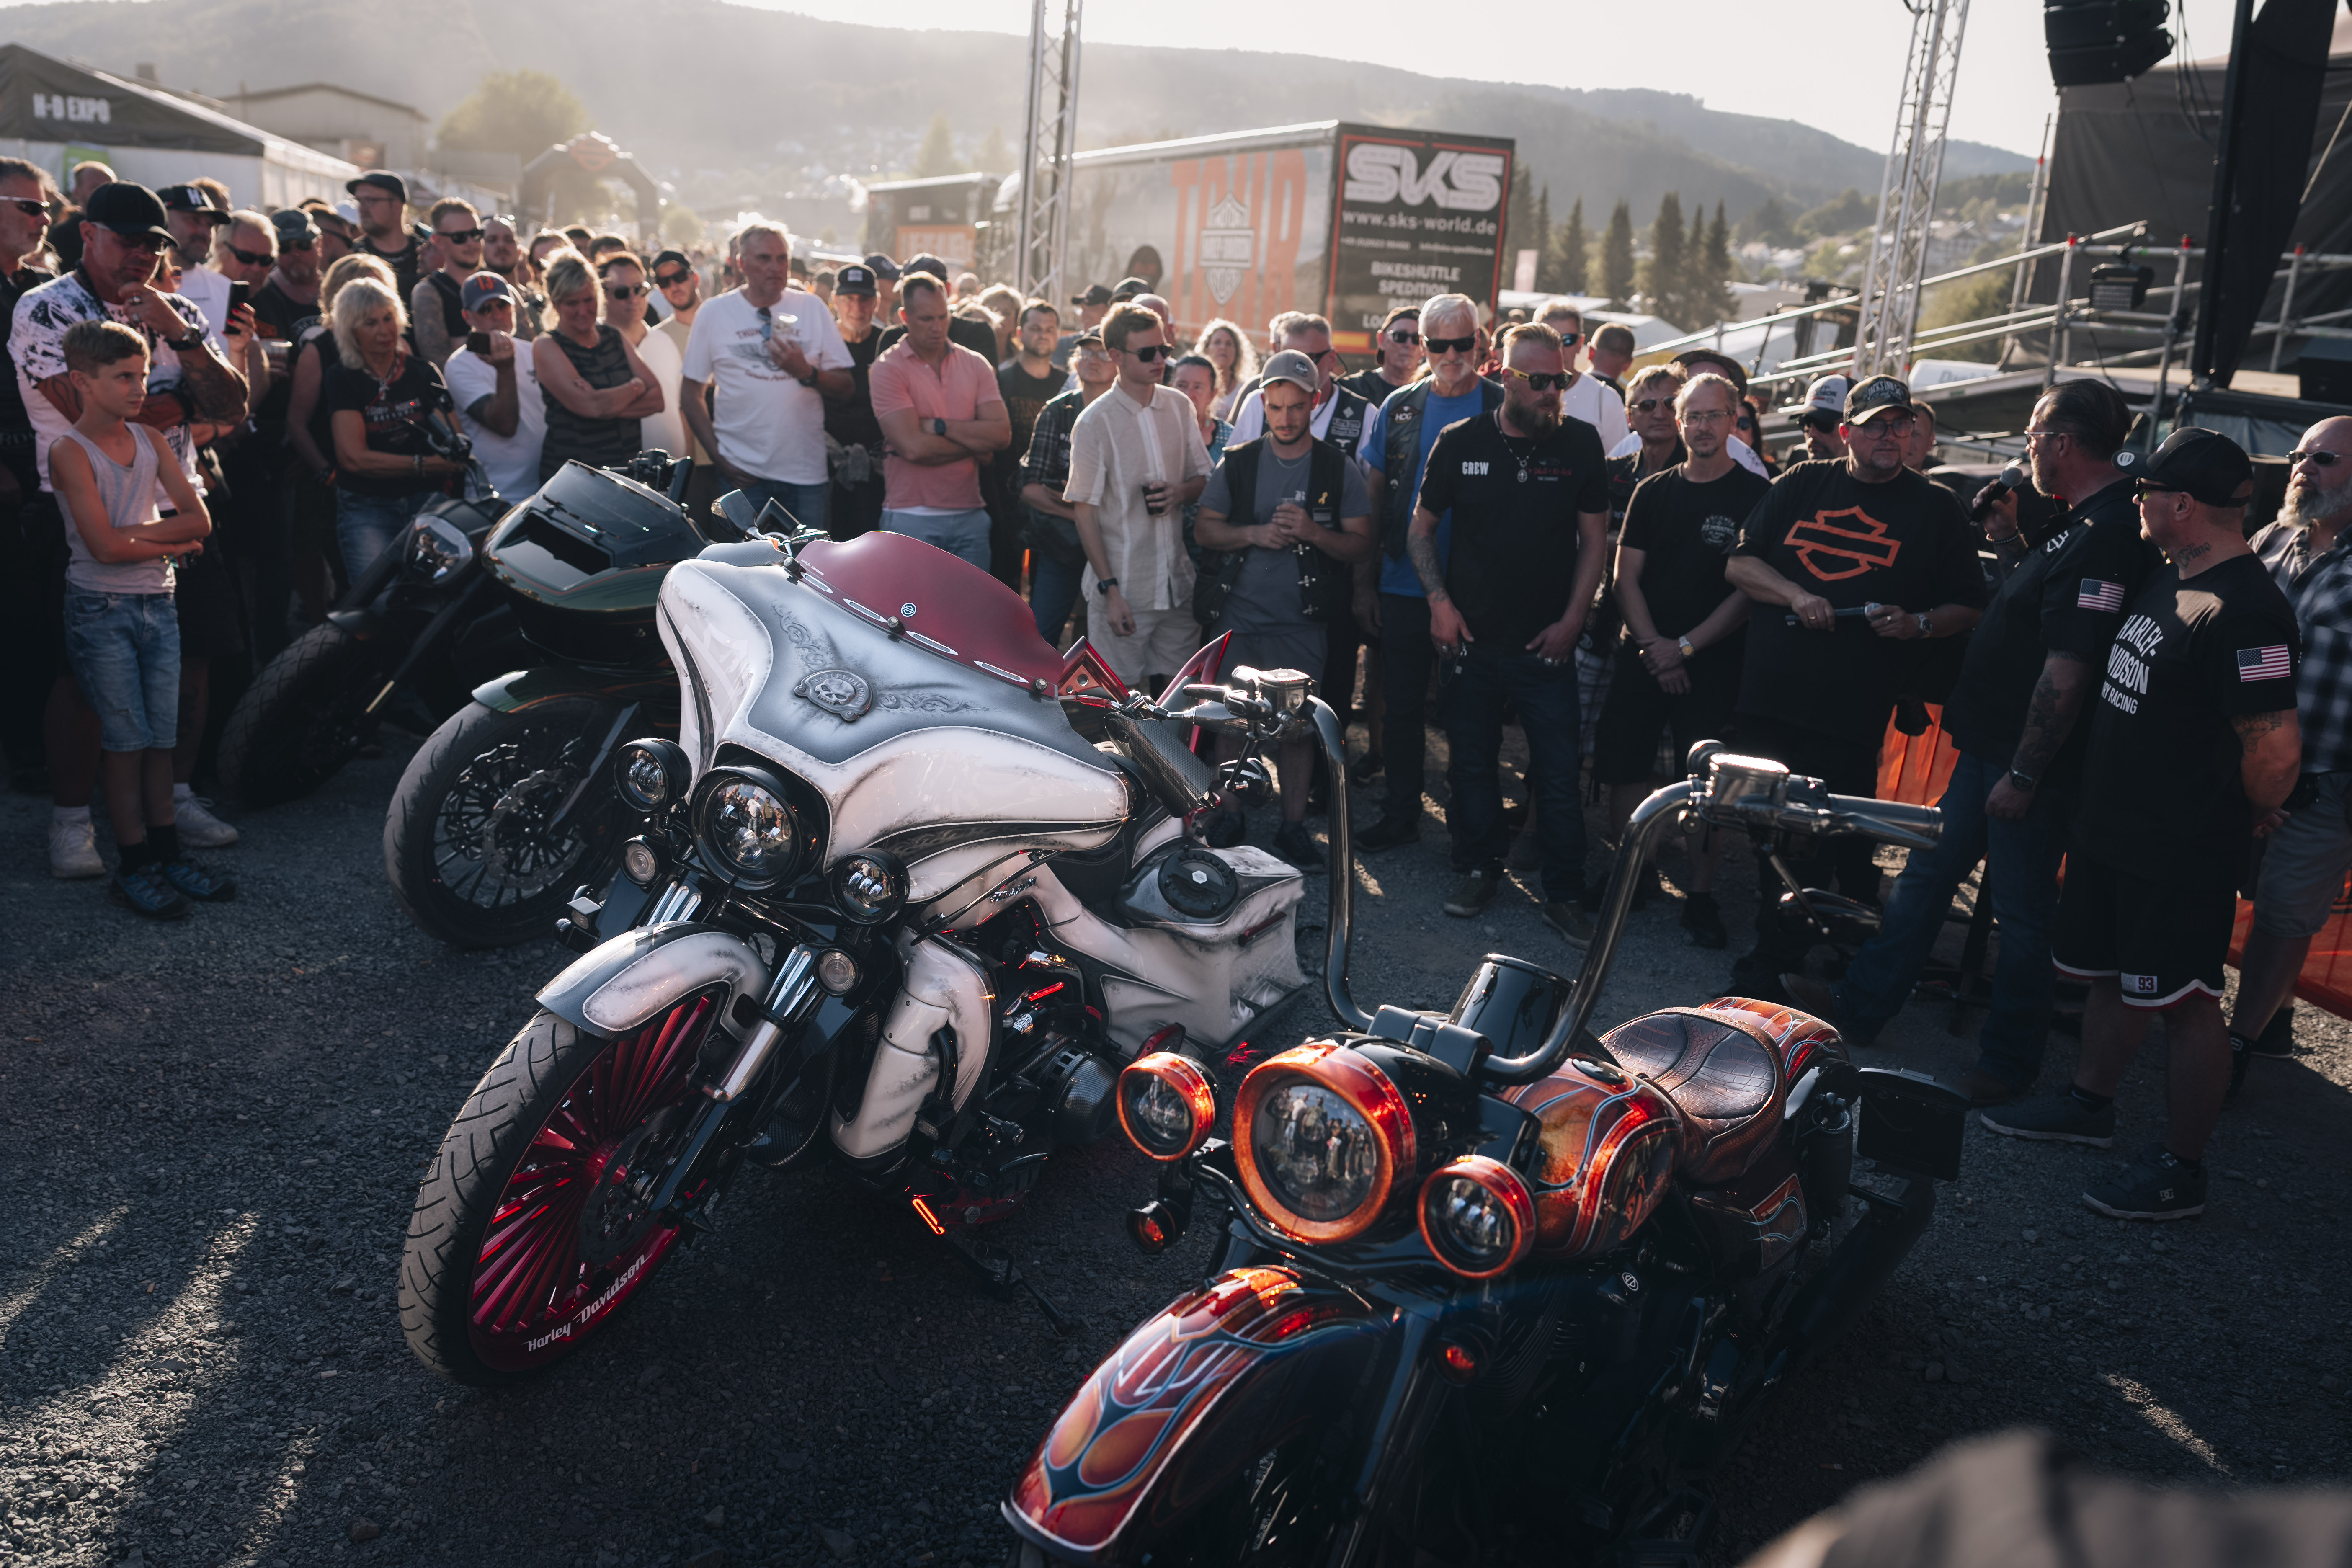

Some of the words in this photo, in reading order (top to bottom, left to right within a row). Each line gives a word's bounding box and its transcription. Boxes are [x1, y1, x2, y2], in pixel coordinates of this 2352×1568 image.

[33, 93, 64, 120] H-D
[67, 96, 111, 124] EXPO
[1344, 143, 1505, 211] SKS
[1342, 209, 1497, 236] www.sks-world.de
[1371, 260, 1461, 282] BIKESHUTTLE
[1378, 279, 1449, 295] SPEDITION
[1462, 461, 1489, 475] CREW
[801, 559, 812, 567] HARLEY
[811, 565, 825, 576] DAVIDSON
[811, 673, 865, 705] HARLEY-DAVIDSON
[2108, 687, 2138, 714] RACING
[2138, 977, 2154, 991] 93
